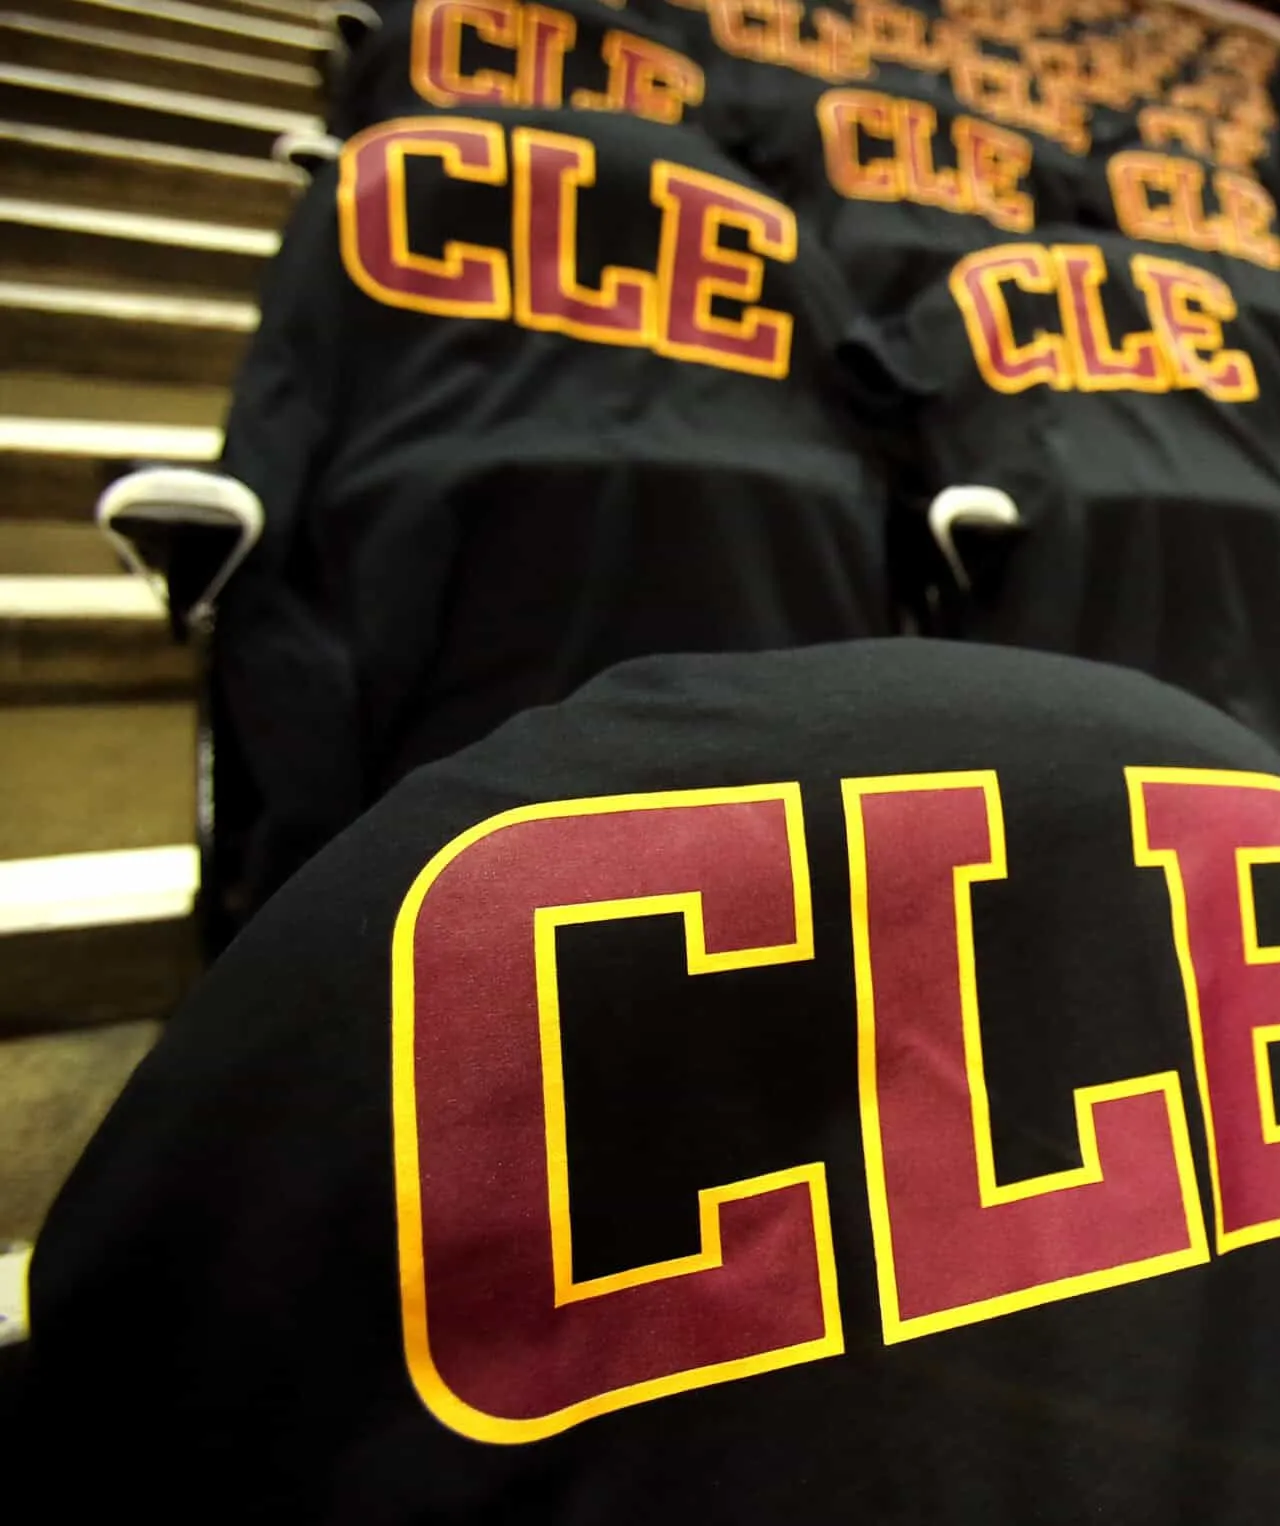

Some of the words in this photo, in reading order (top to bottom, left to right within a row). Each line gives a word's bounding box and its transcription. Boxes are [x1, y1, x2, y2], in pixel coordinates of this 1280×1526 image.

[817, 88, 1034, 233] CLE
[337, 115, 798, 379] CLE
[948, 243, 1258, 402] CLE
